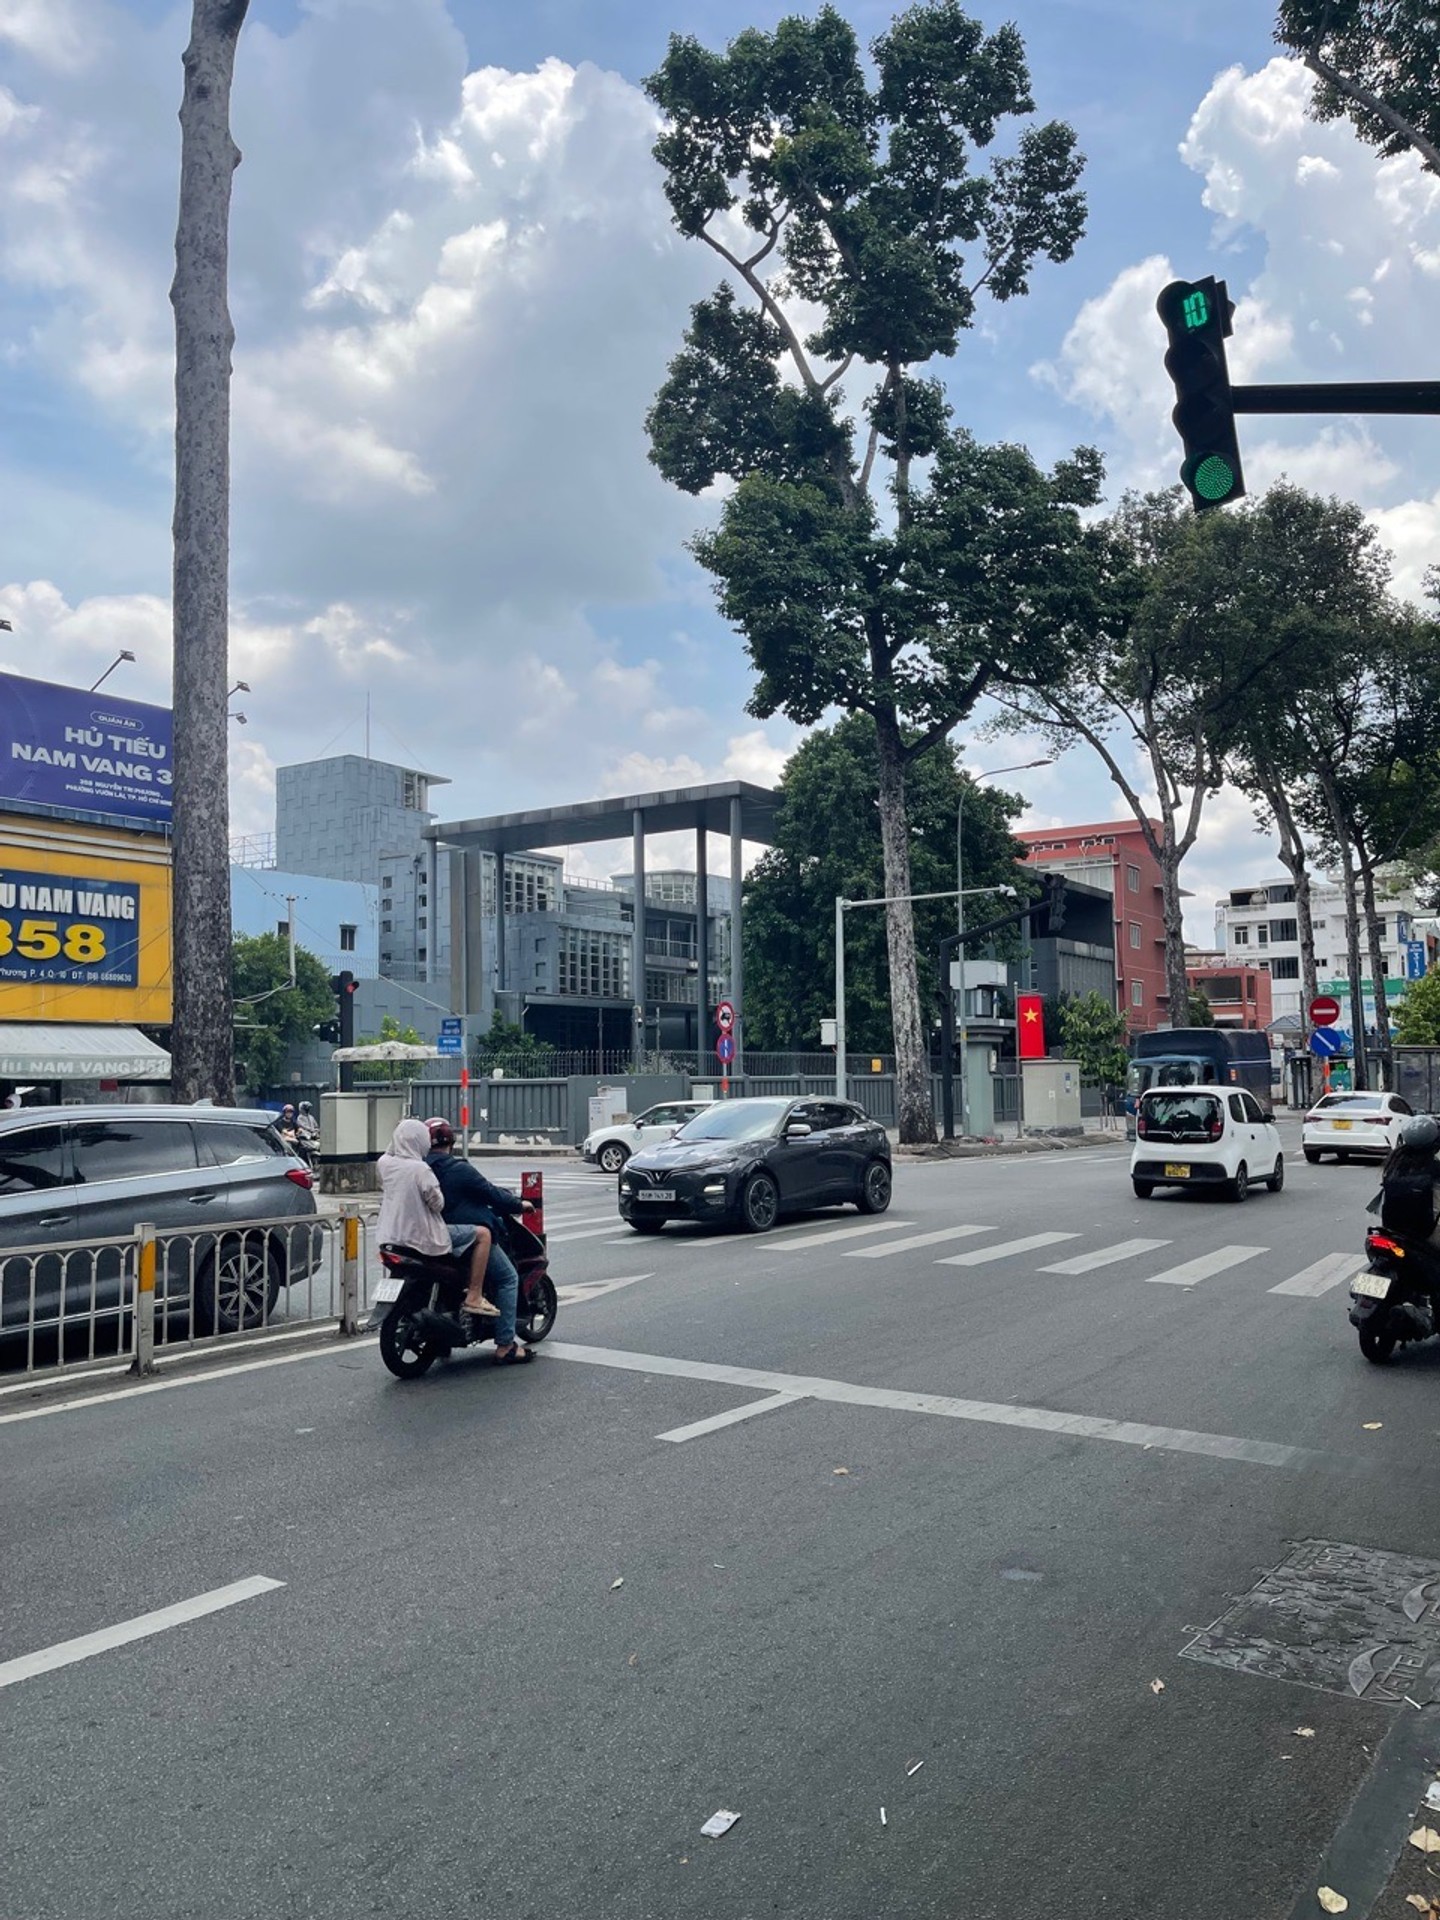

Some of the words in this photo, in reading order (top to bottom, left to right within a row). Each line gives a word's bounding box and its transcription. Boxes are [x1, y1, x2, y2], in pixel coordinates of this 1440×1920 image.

[1183, 291, 1208, 328] 10
[64, 727, 103, 747] HỦ
[107, 735, 166, 759] TIẾU
[11, 742, 76, 769] NAM
[80, 754, 153, 782] VANG
[19, 886, 73, 914] NAM
[77, 891, 135, 920] VANG
[30, 1061, 74, 1073] NAM
[79, 1061, 130, 1073] VANG
